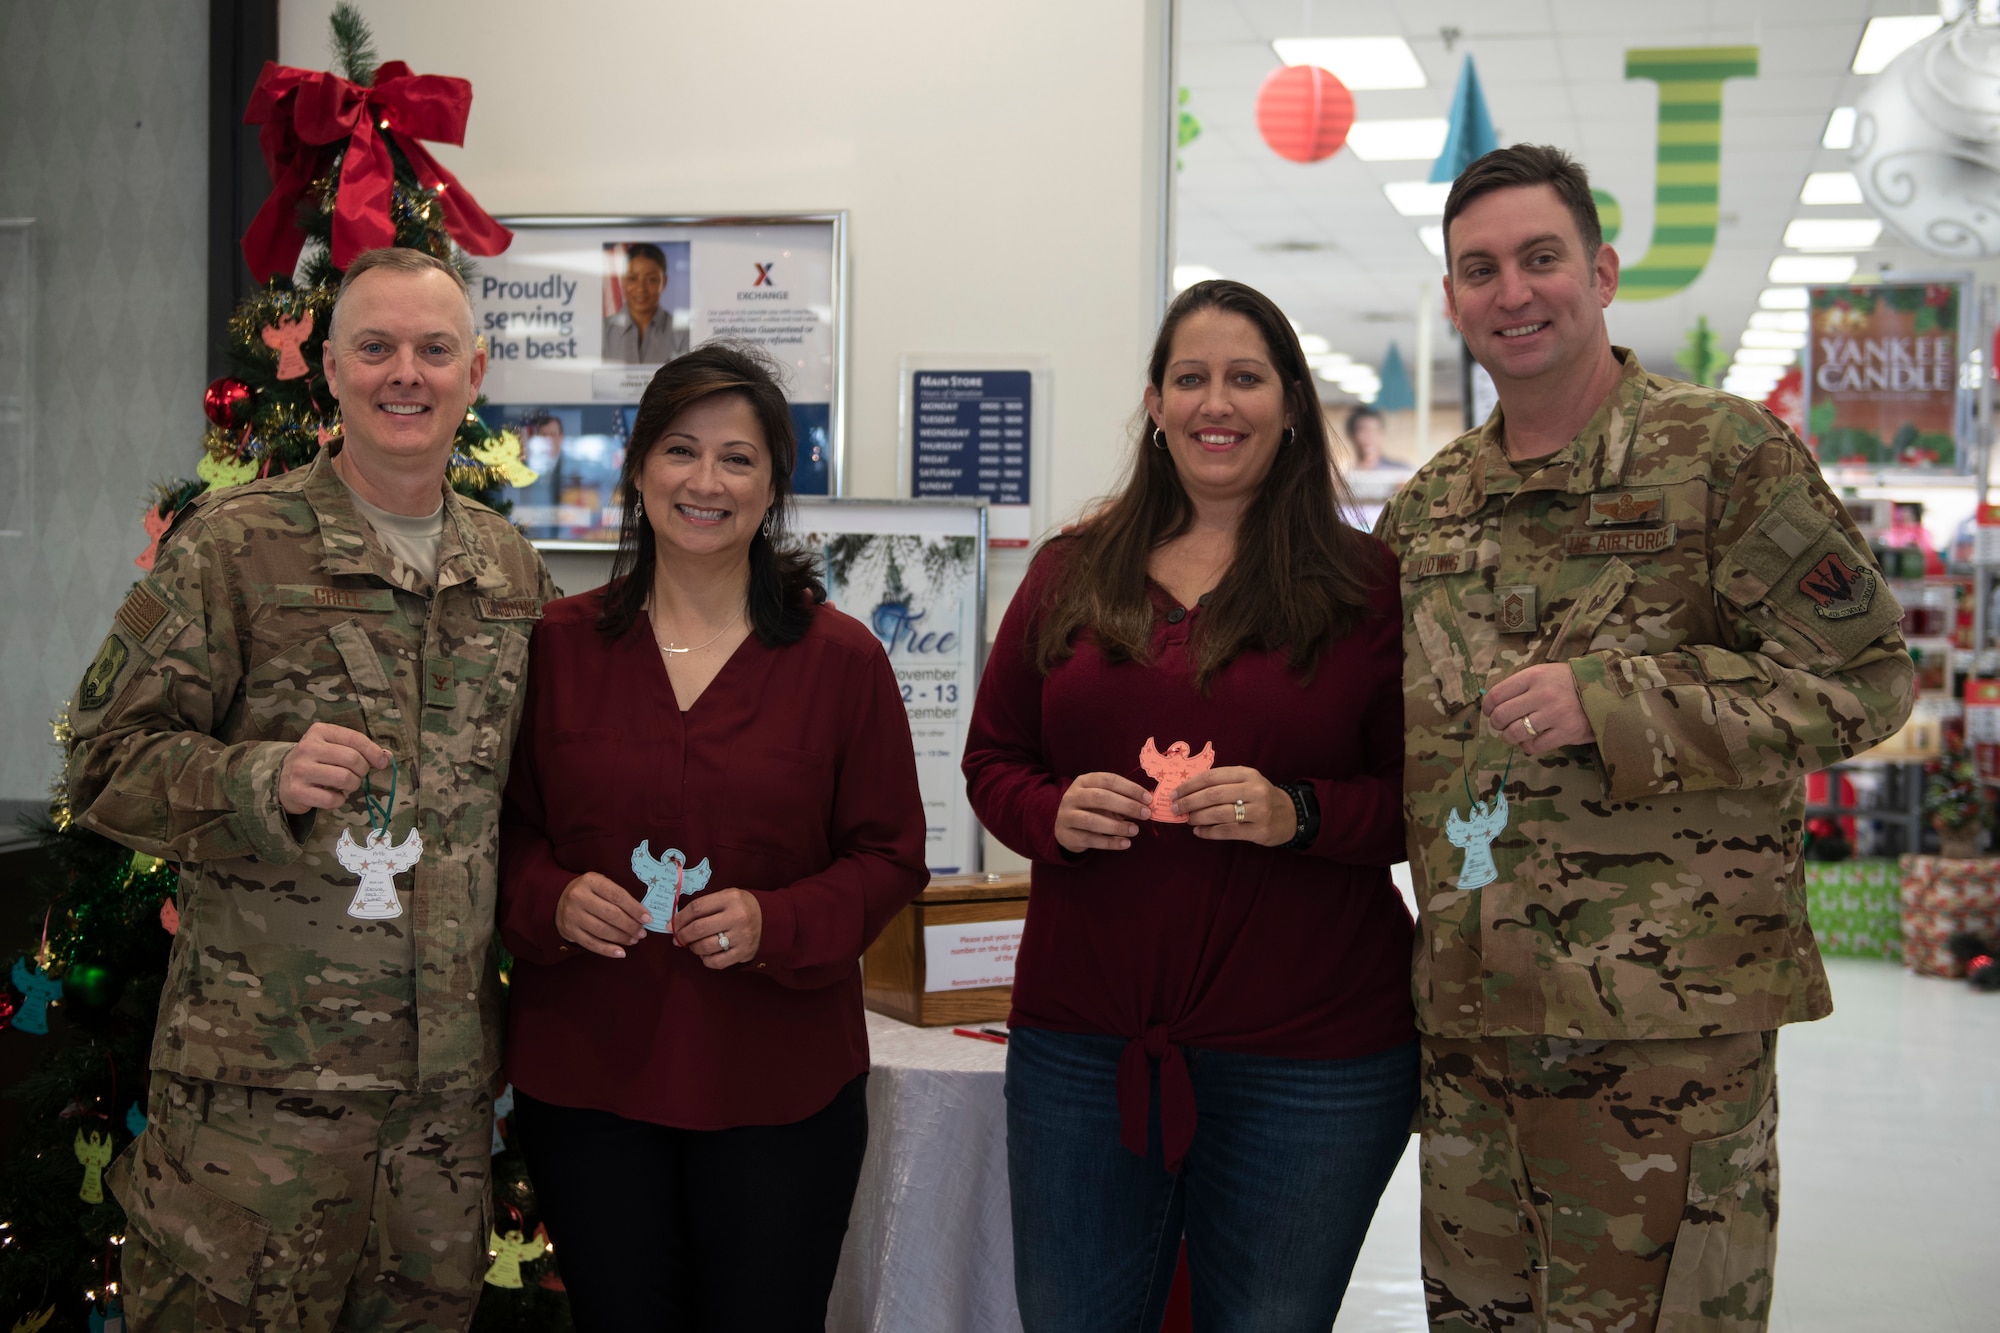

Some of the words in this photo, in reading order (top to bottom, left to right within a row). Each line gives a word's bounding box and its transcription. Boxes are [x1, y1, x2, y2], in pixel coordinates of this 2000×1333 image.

[482, 274, 577, 305] Proudly
[737, 291, 789, 300] EXCHANGE
[484, 304, 574, 336] serving
[713, 325, 757, 336] Satisfaction
[758, 325, 803, 333] Guaranteed
[490, 335, 519, 359] he
[526, 335, 577, 359] best
[1820, 336, 1950, 364] YANKEE
[1817, 363, 1950, 392] CANDLE
[920, 402, 959, 411] MONDAY
[920, 415, 957, 424] TUESDAY
[920, 428, 970, 437] WEDNESDAY
[920, 441, 964, 450] THURSDAY
[920, 455, 949, 464] FRIDAY
[920, 468, 962, 477] SATURDAY
[919, 481, 953, 490] SUNDAY
[1596, 533, 1622, 552] AIR
[1625, 527, 1670, 550] FORCE
[313, 587, 364, 608] CREEL
[1840, 605, 1866, 615] COMBAT
[872, 606, 957, 657] Tree
[934, 684, 958, 703] 13
[907, 706, 958, 719] cember
[951, 947, 976, 955] number
